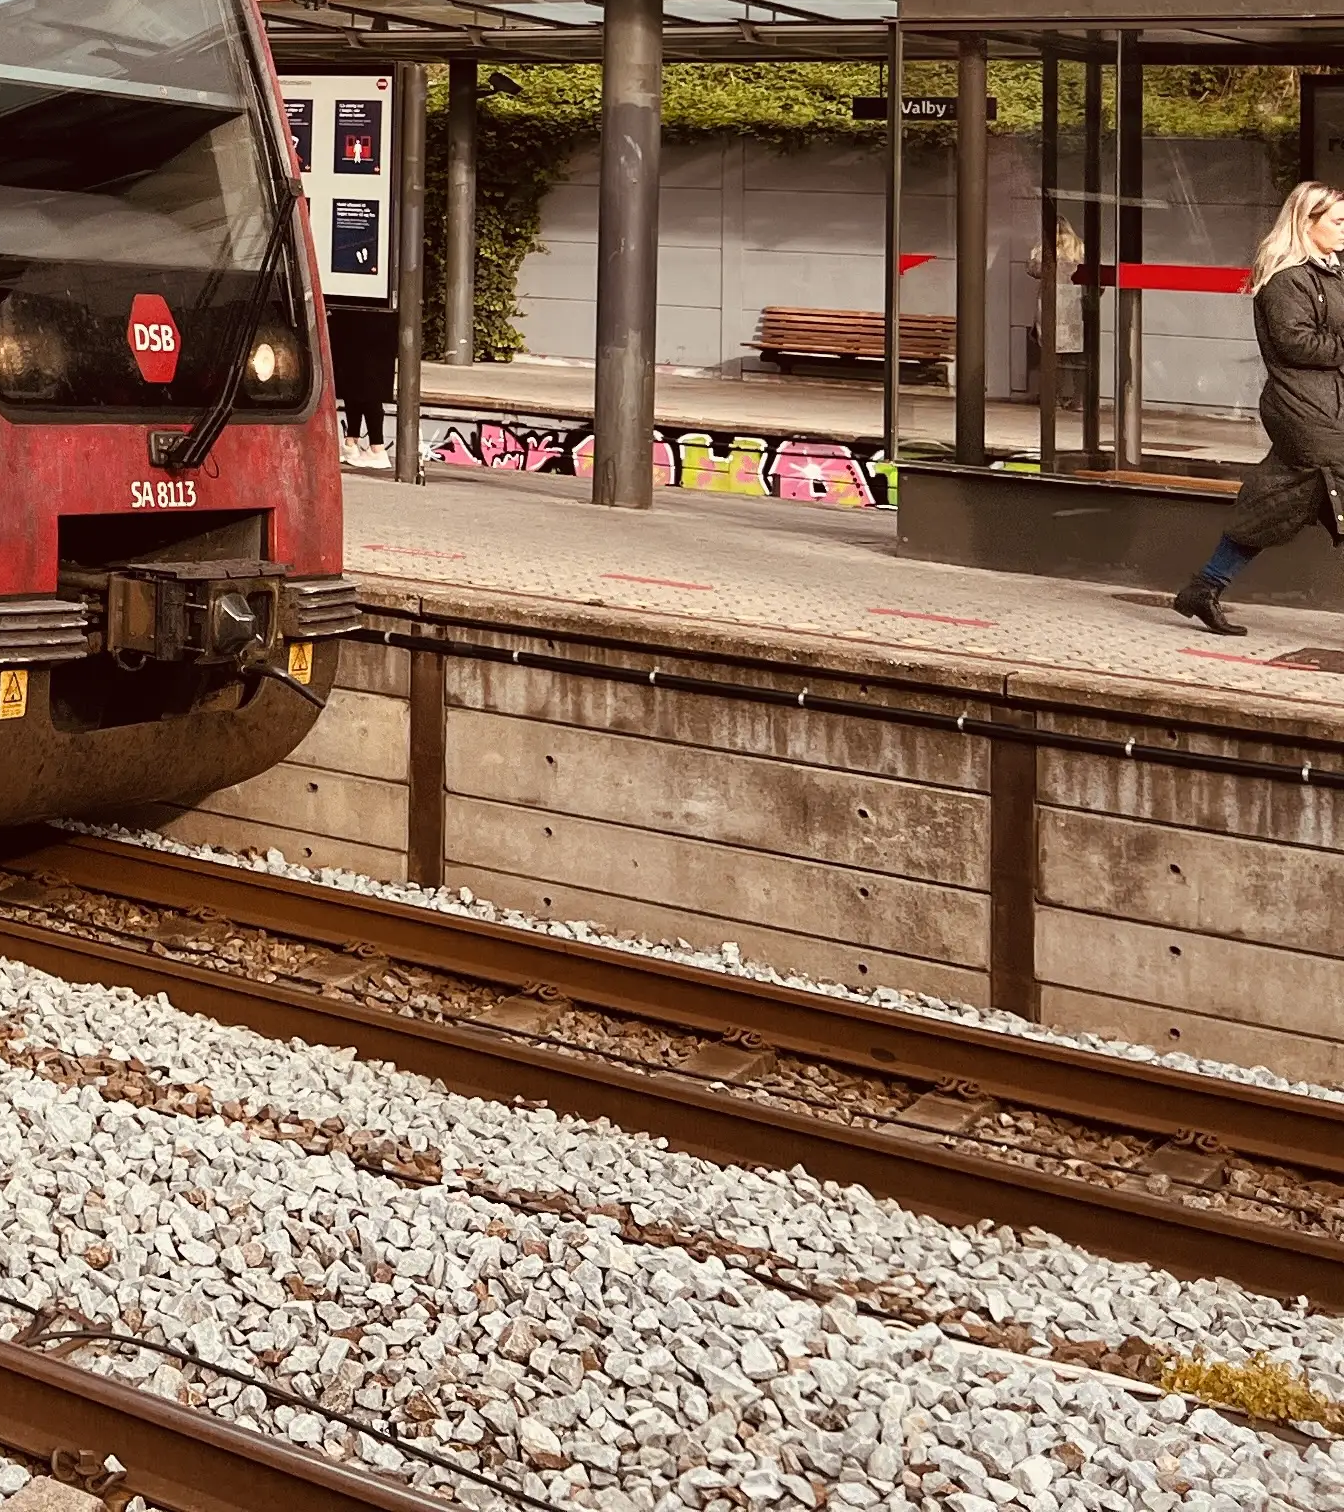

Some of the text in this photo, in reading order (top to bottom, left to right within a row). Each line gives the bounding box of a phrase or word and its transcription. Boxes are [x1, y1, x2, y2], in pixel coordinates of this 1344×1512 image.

[901, 100, 947, 118] Valby
[133, 323, 176, 353] DSB
[130, 480, 197, 509] SA 8113
